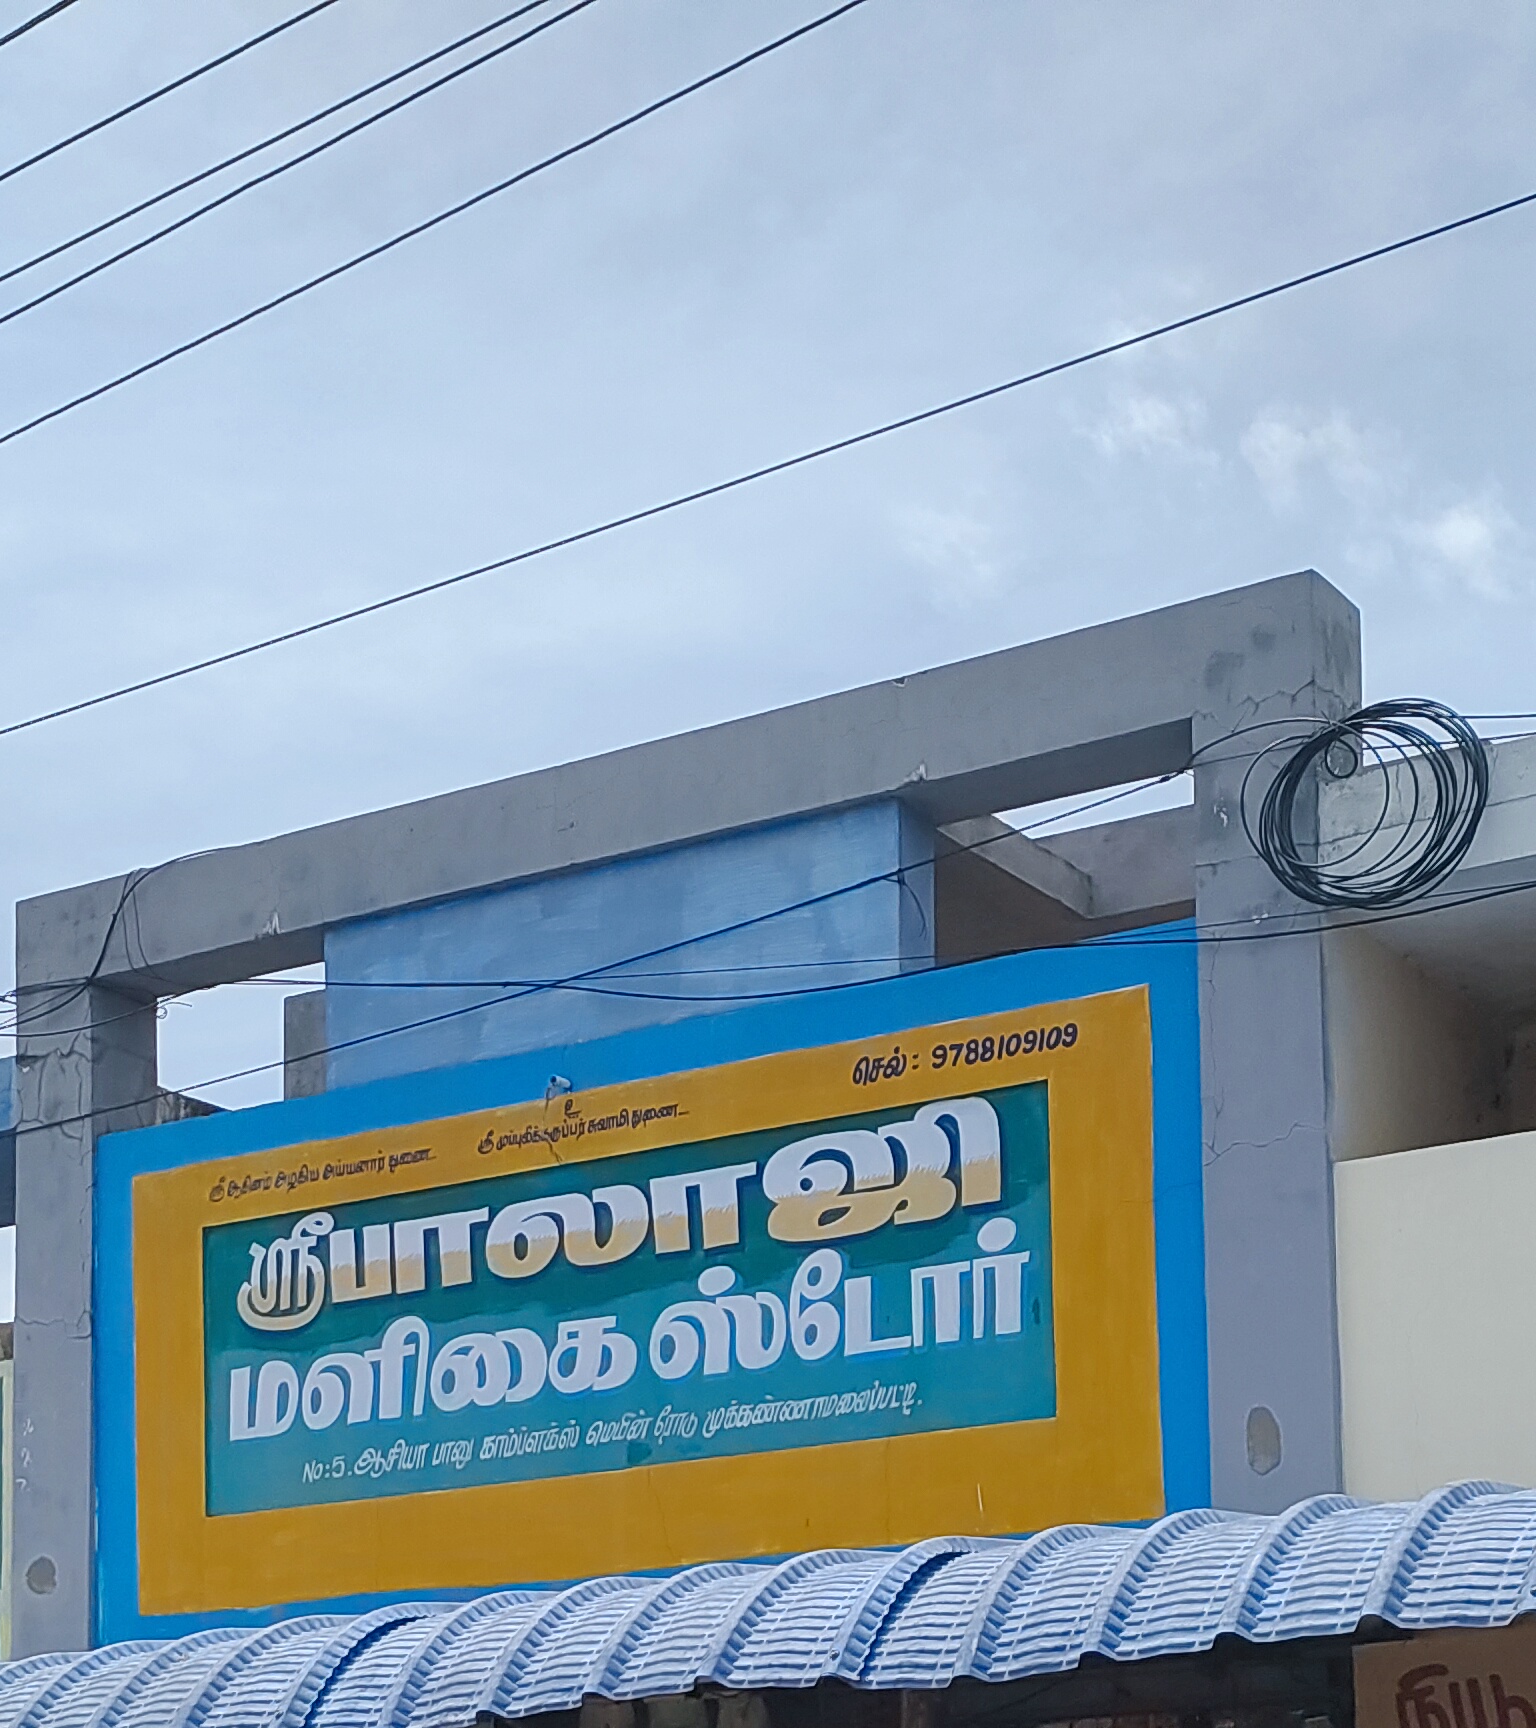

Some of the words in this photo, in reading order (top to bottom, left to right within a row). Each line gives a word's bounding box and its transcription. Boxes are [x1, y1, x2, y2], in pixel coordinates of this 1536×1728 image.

[931, 1023, 1078, 1069] 9788109109
[229, 1314, 638, 1442] மளிகை
[649, 1218, 1031, 1379] ஸ்டோர்
